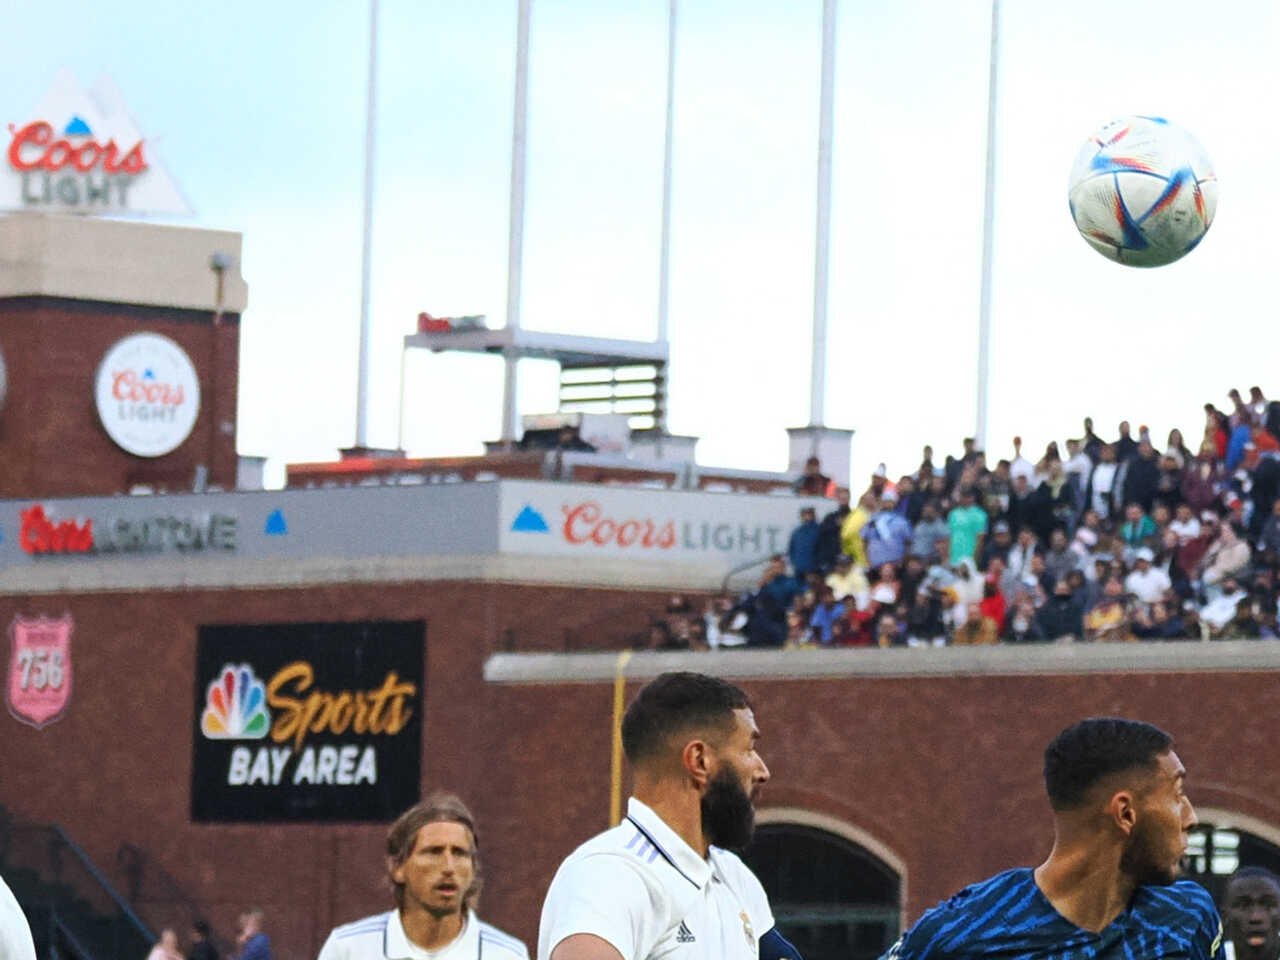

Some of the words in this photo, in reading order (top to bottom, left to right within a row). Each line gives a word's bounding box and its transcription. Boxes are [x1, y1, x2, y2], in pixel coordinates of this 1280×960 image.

[8, 120, 148, 175] Coors
[22, 172, 136, 206] LIGHT
[111, 369, 185, 406] Coors
[117, 404, 177, 423] LIGHT
[562, 501, 676, 549] Coors
[683, 521, 785, 552] LIGHT
[18, 648, 64, 690] 756
[267, 661, 416, 751] Sports
[227, 747, 292, 786] BAY
[292, 746, 377, 786] AREA
